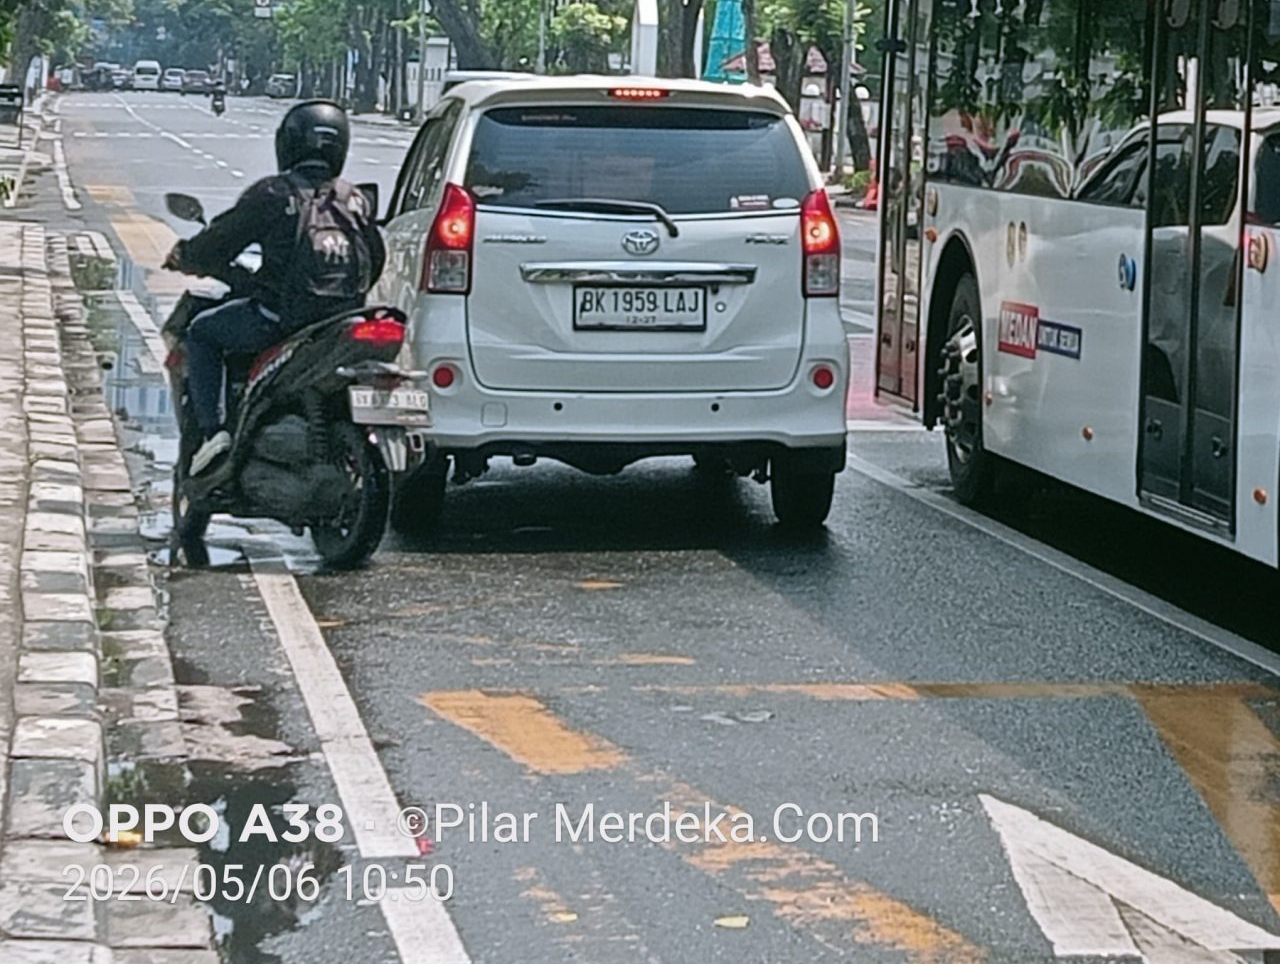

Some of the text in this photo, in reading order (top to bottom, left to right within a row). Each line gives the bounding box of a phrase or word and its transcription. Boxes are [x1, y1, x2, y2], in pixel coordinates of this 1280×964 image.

[582, 291, 699, 313] BK 1959 LAJ
